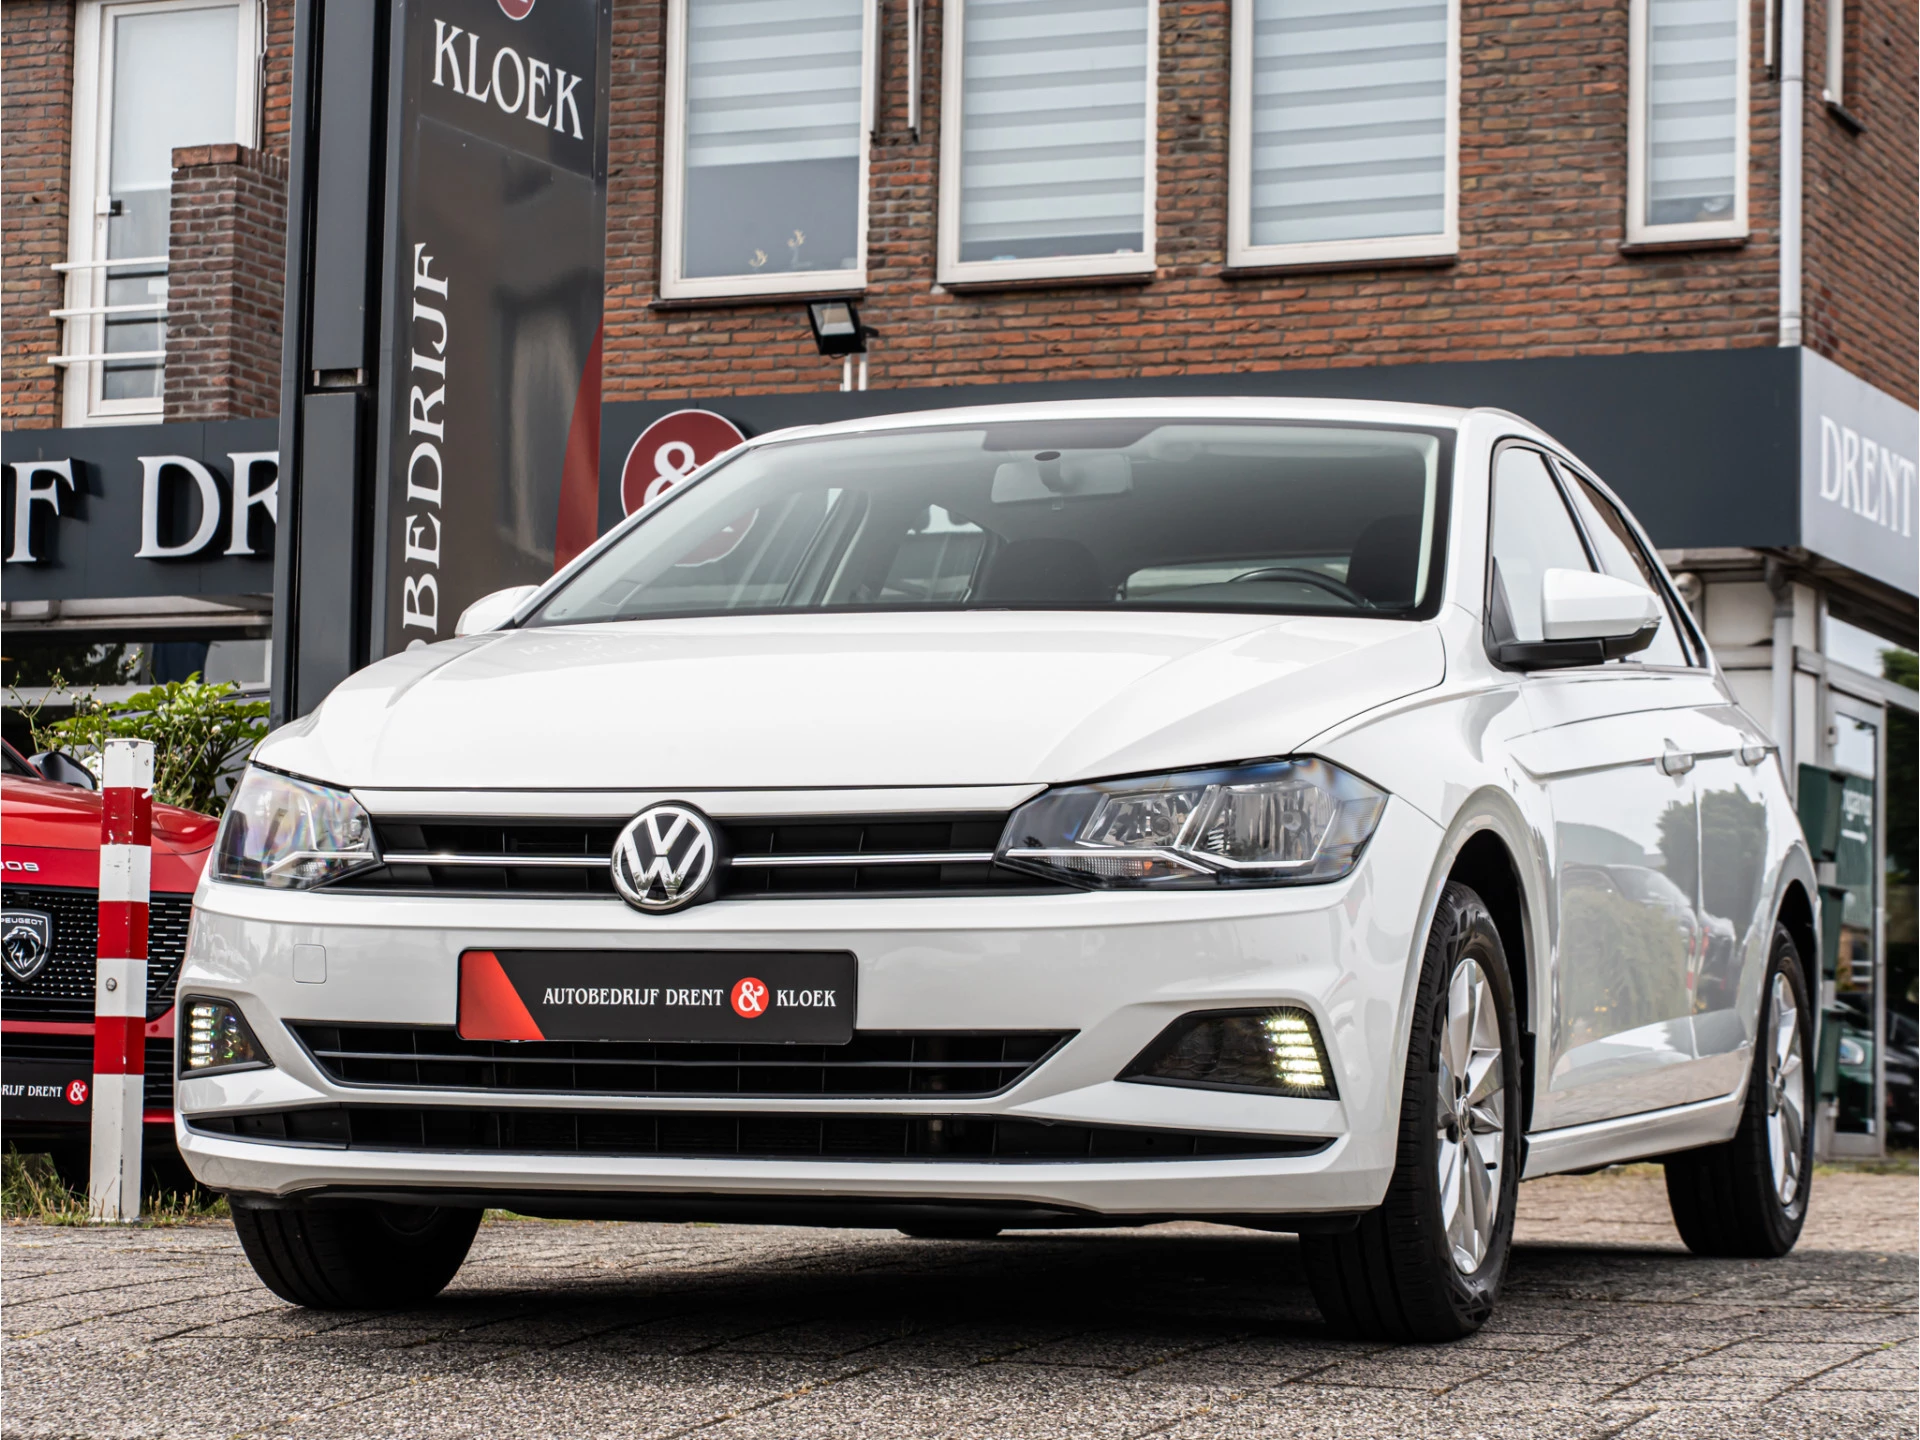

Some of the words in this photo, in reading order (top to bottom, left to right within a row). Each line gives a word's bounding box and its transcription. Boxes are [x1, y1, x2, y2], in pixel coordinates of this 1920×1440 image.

[432, 19, 584, 141] KLOEK
[1819, 414, 1916, 537] DRENT
[542, 987, 660, 1006] AUTOBEDRIJF
[665, 988, 724, 1006] DRENT
[738, 982, 765, 1012] &
[776, 989, 837, 1007] KLOEK
[1, 1084, 25, 1096] RIJF
[28, 1085, 62, 1097] DRENT
[70, 1082, 86, 1102] &
